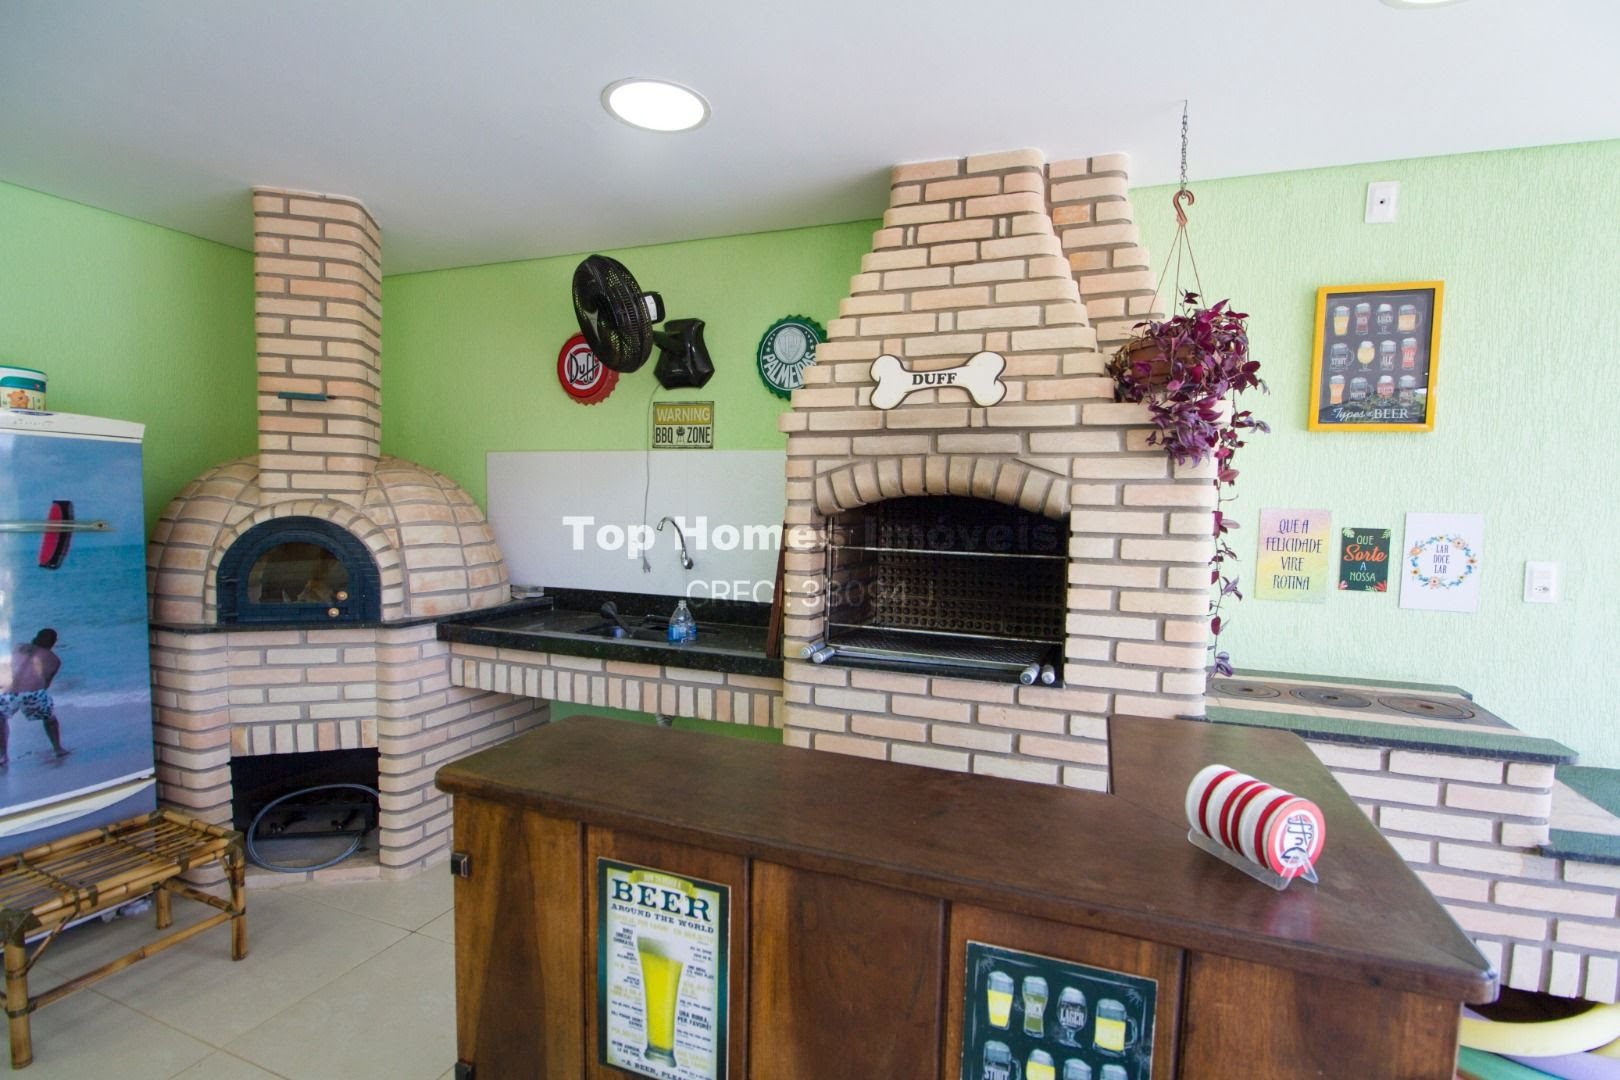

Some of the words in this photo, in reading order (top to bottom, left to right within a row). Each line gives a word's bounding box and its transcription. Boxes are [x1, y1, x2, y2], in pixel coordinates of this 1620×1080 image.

[568, 353, 600, 384] Duff
[912, 372, 957, 385] DUFF
[656, 407, 711, 422] WARNING
[1332, 407, 1365, 421] Types
[1374, 408, 1409, 419] BEER
[655, 426, 673, 444] BBQ
[687, 426, 711, 444] ZONE
[1279, 519, 1300, 534] QUE
[1301, 519, 1309, 534] A
[1266, 537, 1323, 553] FELICIDADE
[1356, 535, 1374, 545] QUE
[1343, 544, 1387, 563] Sorte
[1436, 544, 1449, 554] LAR
[1281, 556, 1304, 572] VIRE
[1360, 562, 1367, 571] A
[1433, 554, 1450, 564] DOCE
[1350, 572, 1376, 582] NOSSA
[1434, 565, 1447, 574] LAR
[1273, 575, 1310, 591] ROTINA
[611, 878, 711, 922] BEER
[611, 903, 651, 918] AROUND
[654, 913, 674, 924] THE
[678, 919, 714, 933] WORLD
